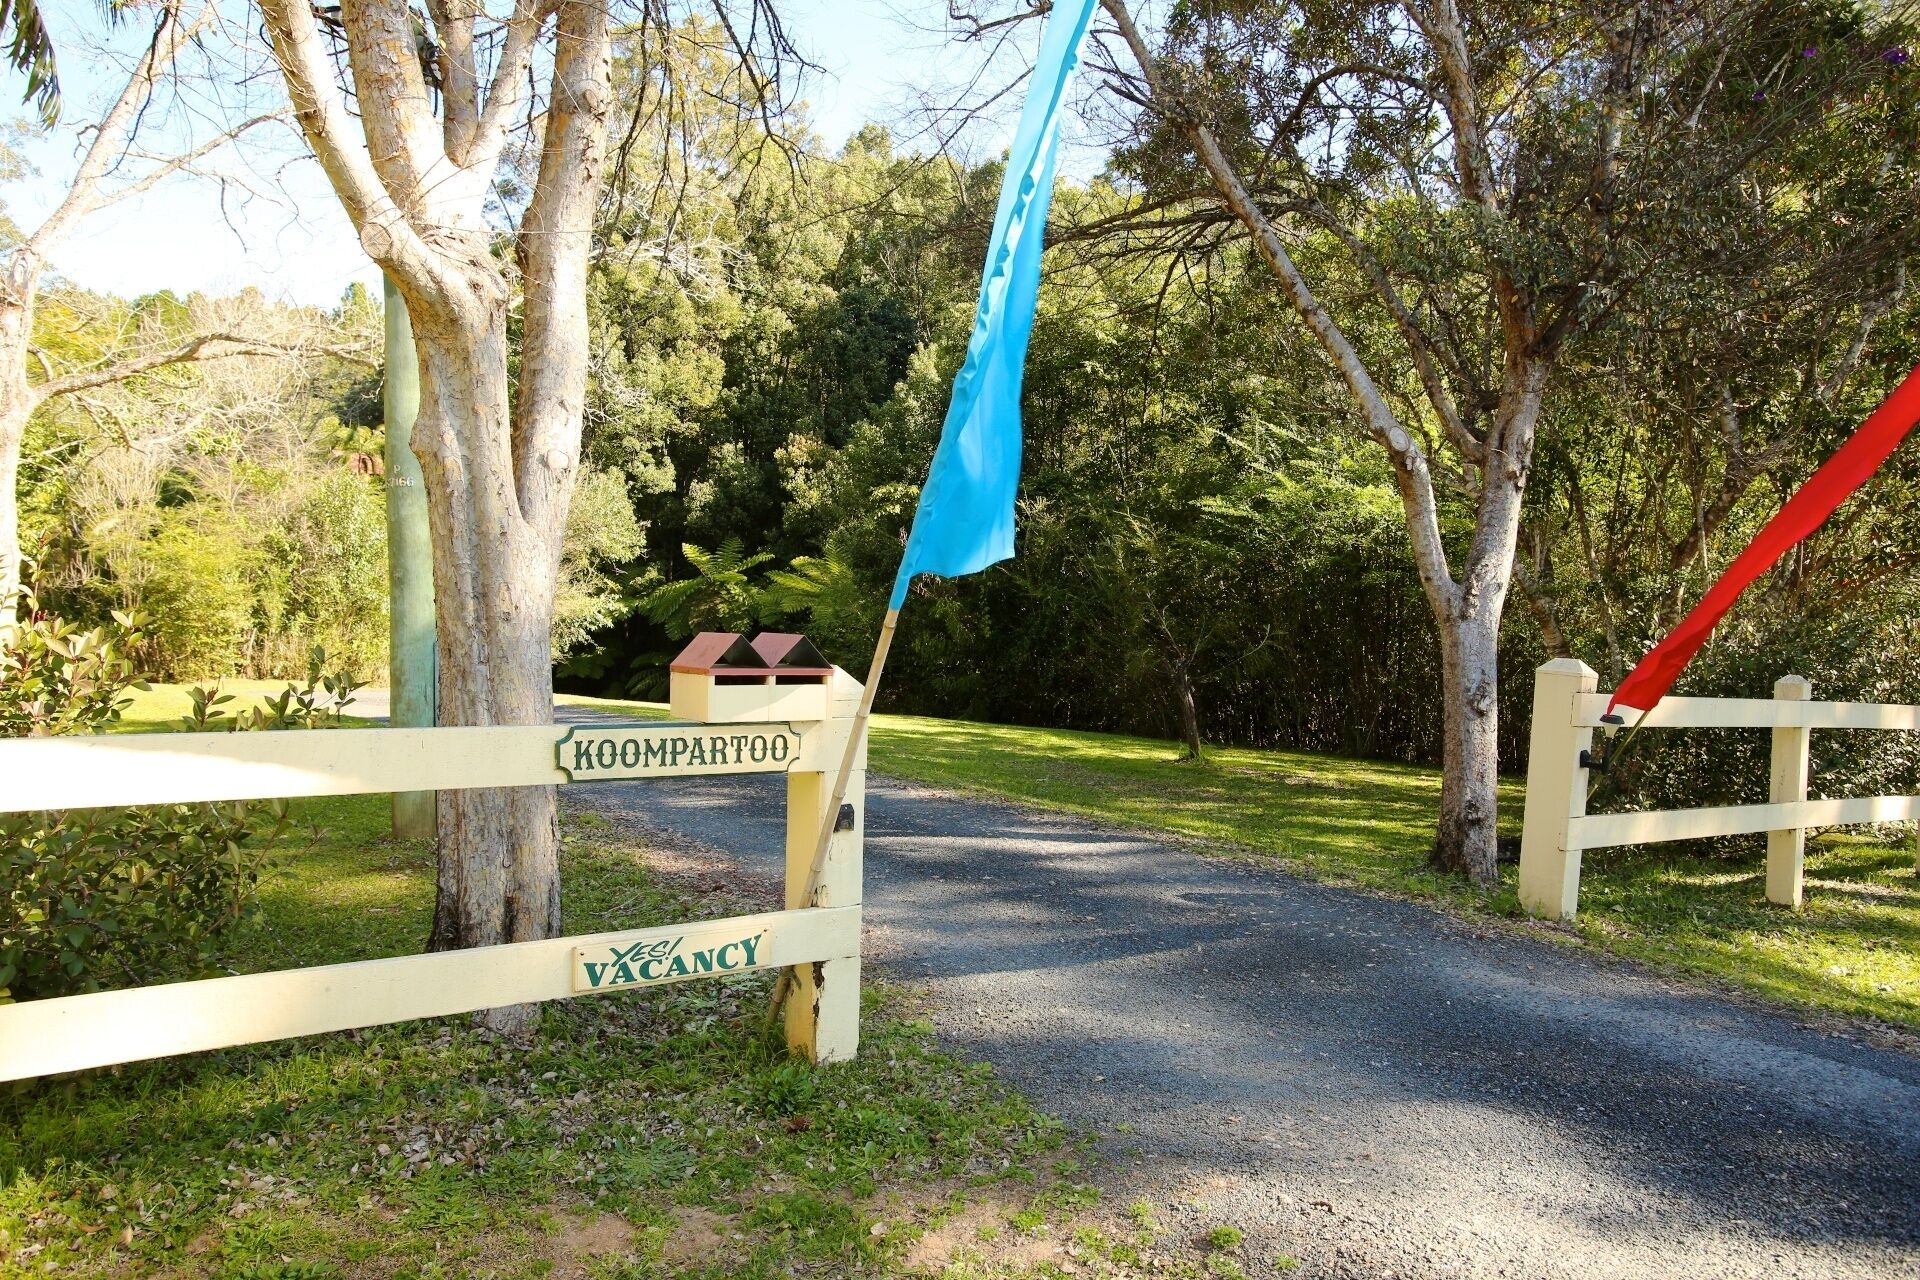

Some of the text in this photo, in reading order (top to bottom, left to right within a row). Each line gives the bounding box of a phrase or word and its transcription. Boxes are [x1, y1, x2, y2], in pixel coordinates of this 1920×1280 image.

[393, 464, 401, 474] P
[573, 734, 789, 771] KOOMPARTOO
[584, 934, 762, 987] VACANCY
[609, 937, 684, 967] YES!
